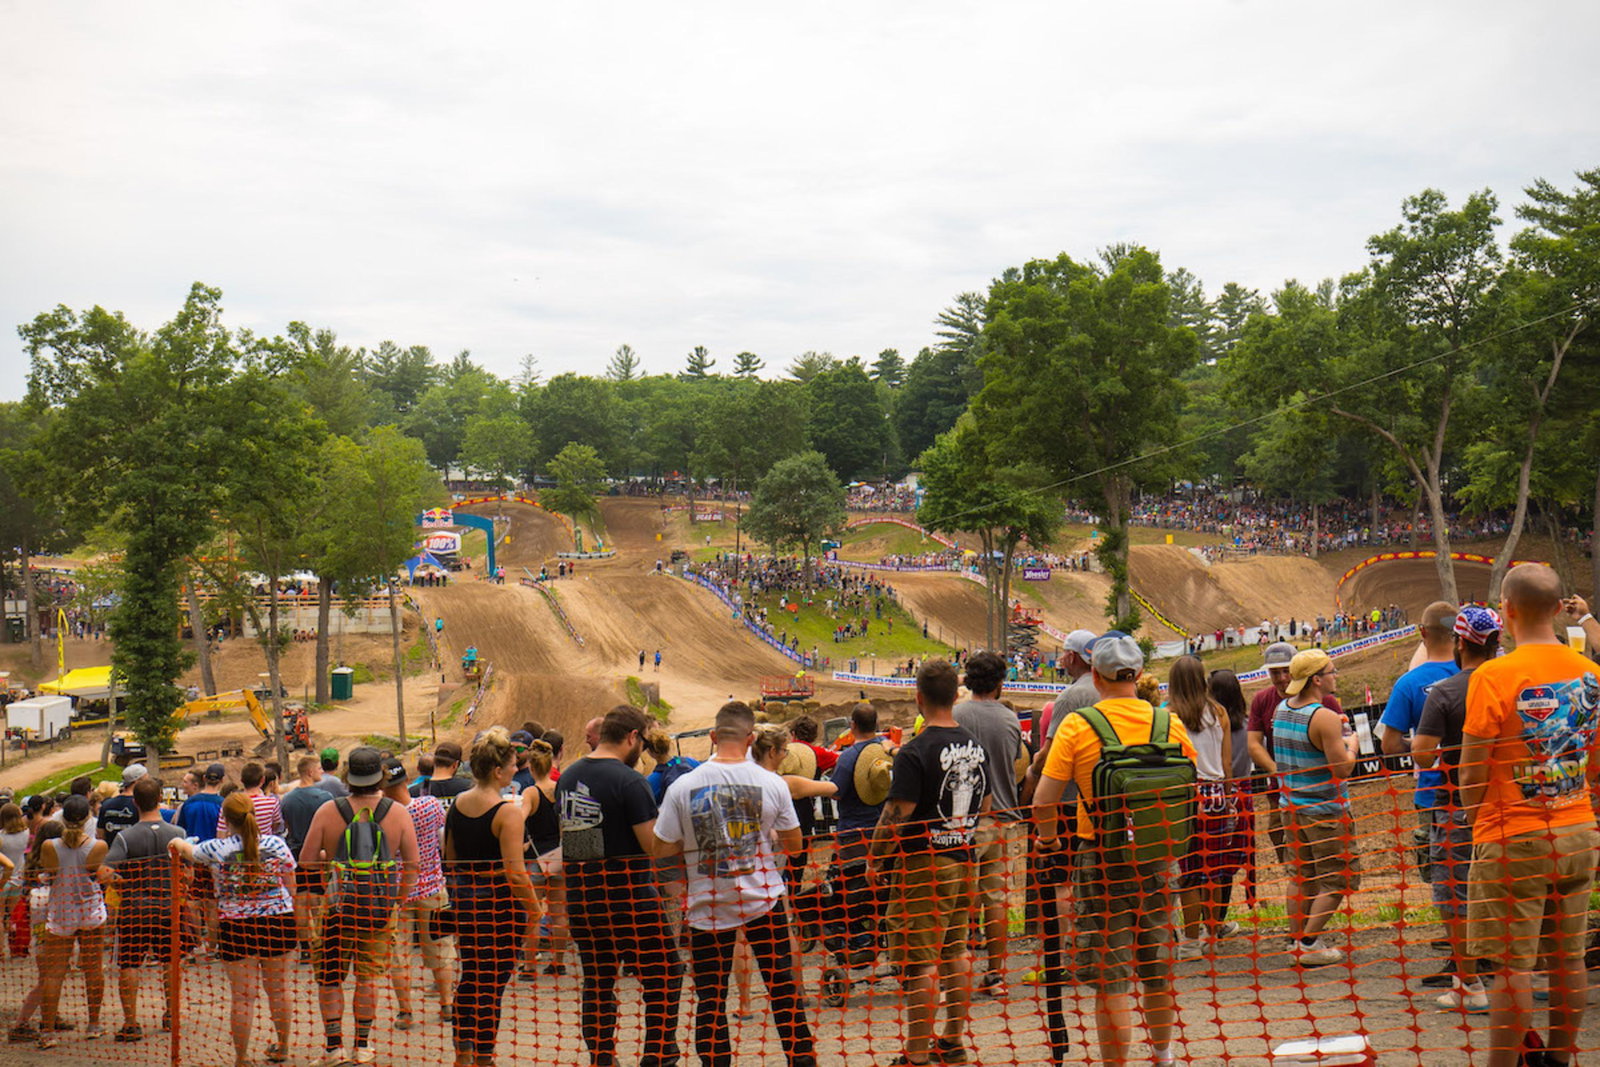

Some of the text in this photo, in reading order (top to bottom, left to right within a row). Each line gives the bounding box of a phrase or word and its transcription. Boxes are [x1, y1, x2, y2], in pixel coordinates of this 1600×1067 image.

[429, 537, 456, 550] 100%
[1328, 645, 1352, 656] ARTS
[1353, 637, 1378, 648] PARTS
[1379, 631, 1402, 640] PARTS
[1238, 671, 1267, 680] PARTS
